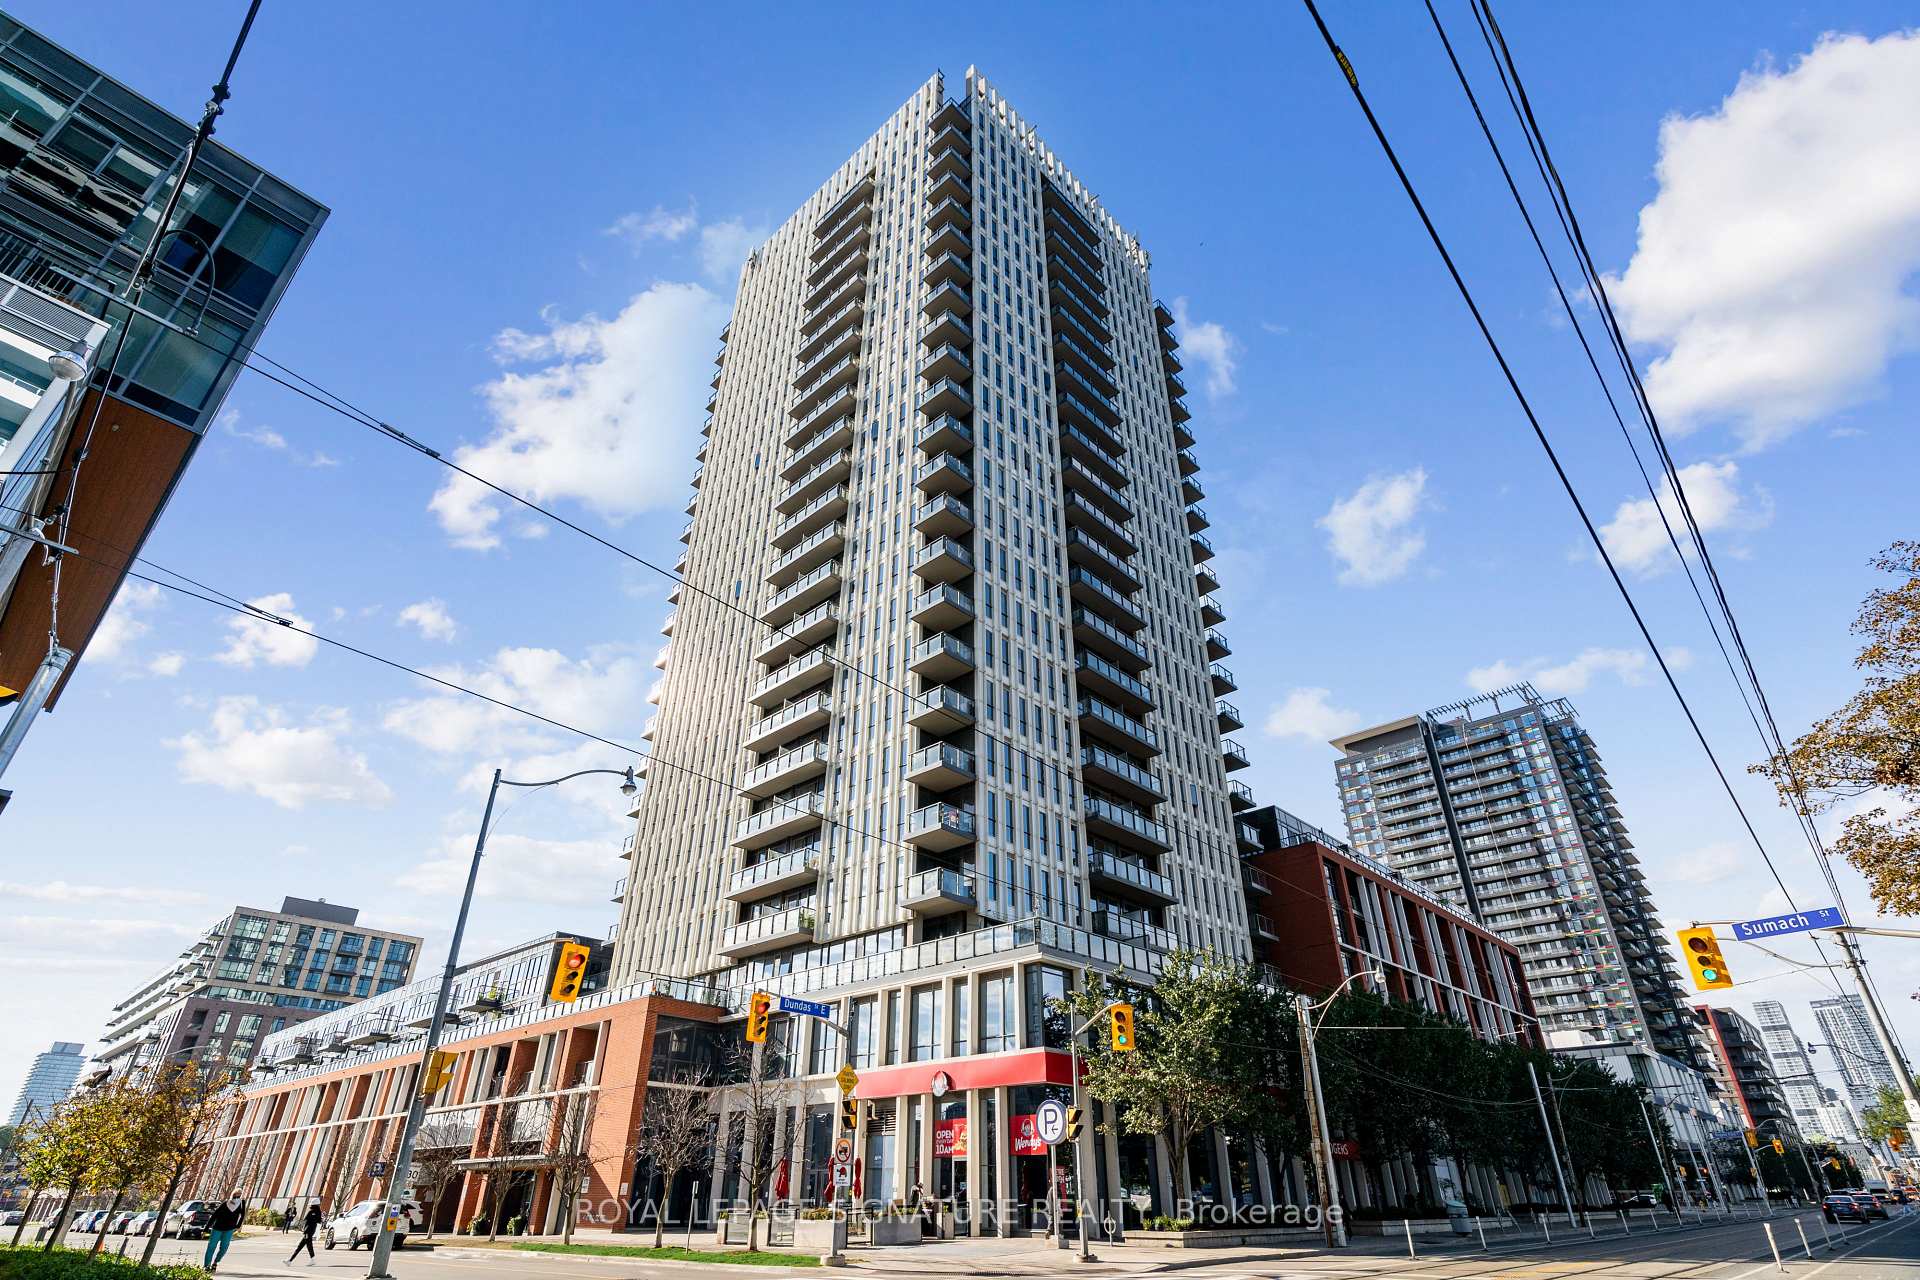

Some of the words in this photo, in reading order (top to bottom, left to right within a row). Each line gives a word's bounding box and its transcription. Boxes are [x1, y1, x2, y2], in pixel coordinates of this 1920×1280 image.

[1741, 914, 1810, 936] Sumach
[1819, 909, 1830, 918] St
[784, 998, 811, 1012] Dundas
[820, 1005, 826, 1015] E
[1043, 1108, 1058, 1135] P
[936, 1129, 954, 1140] OPEN
